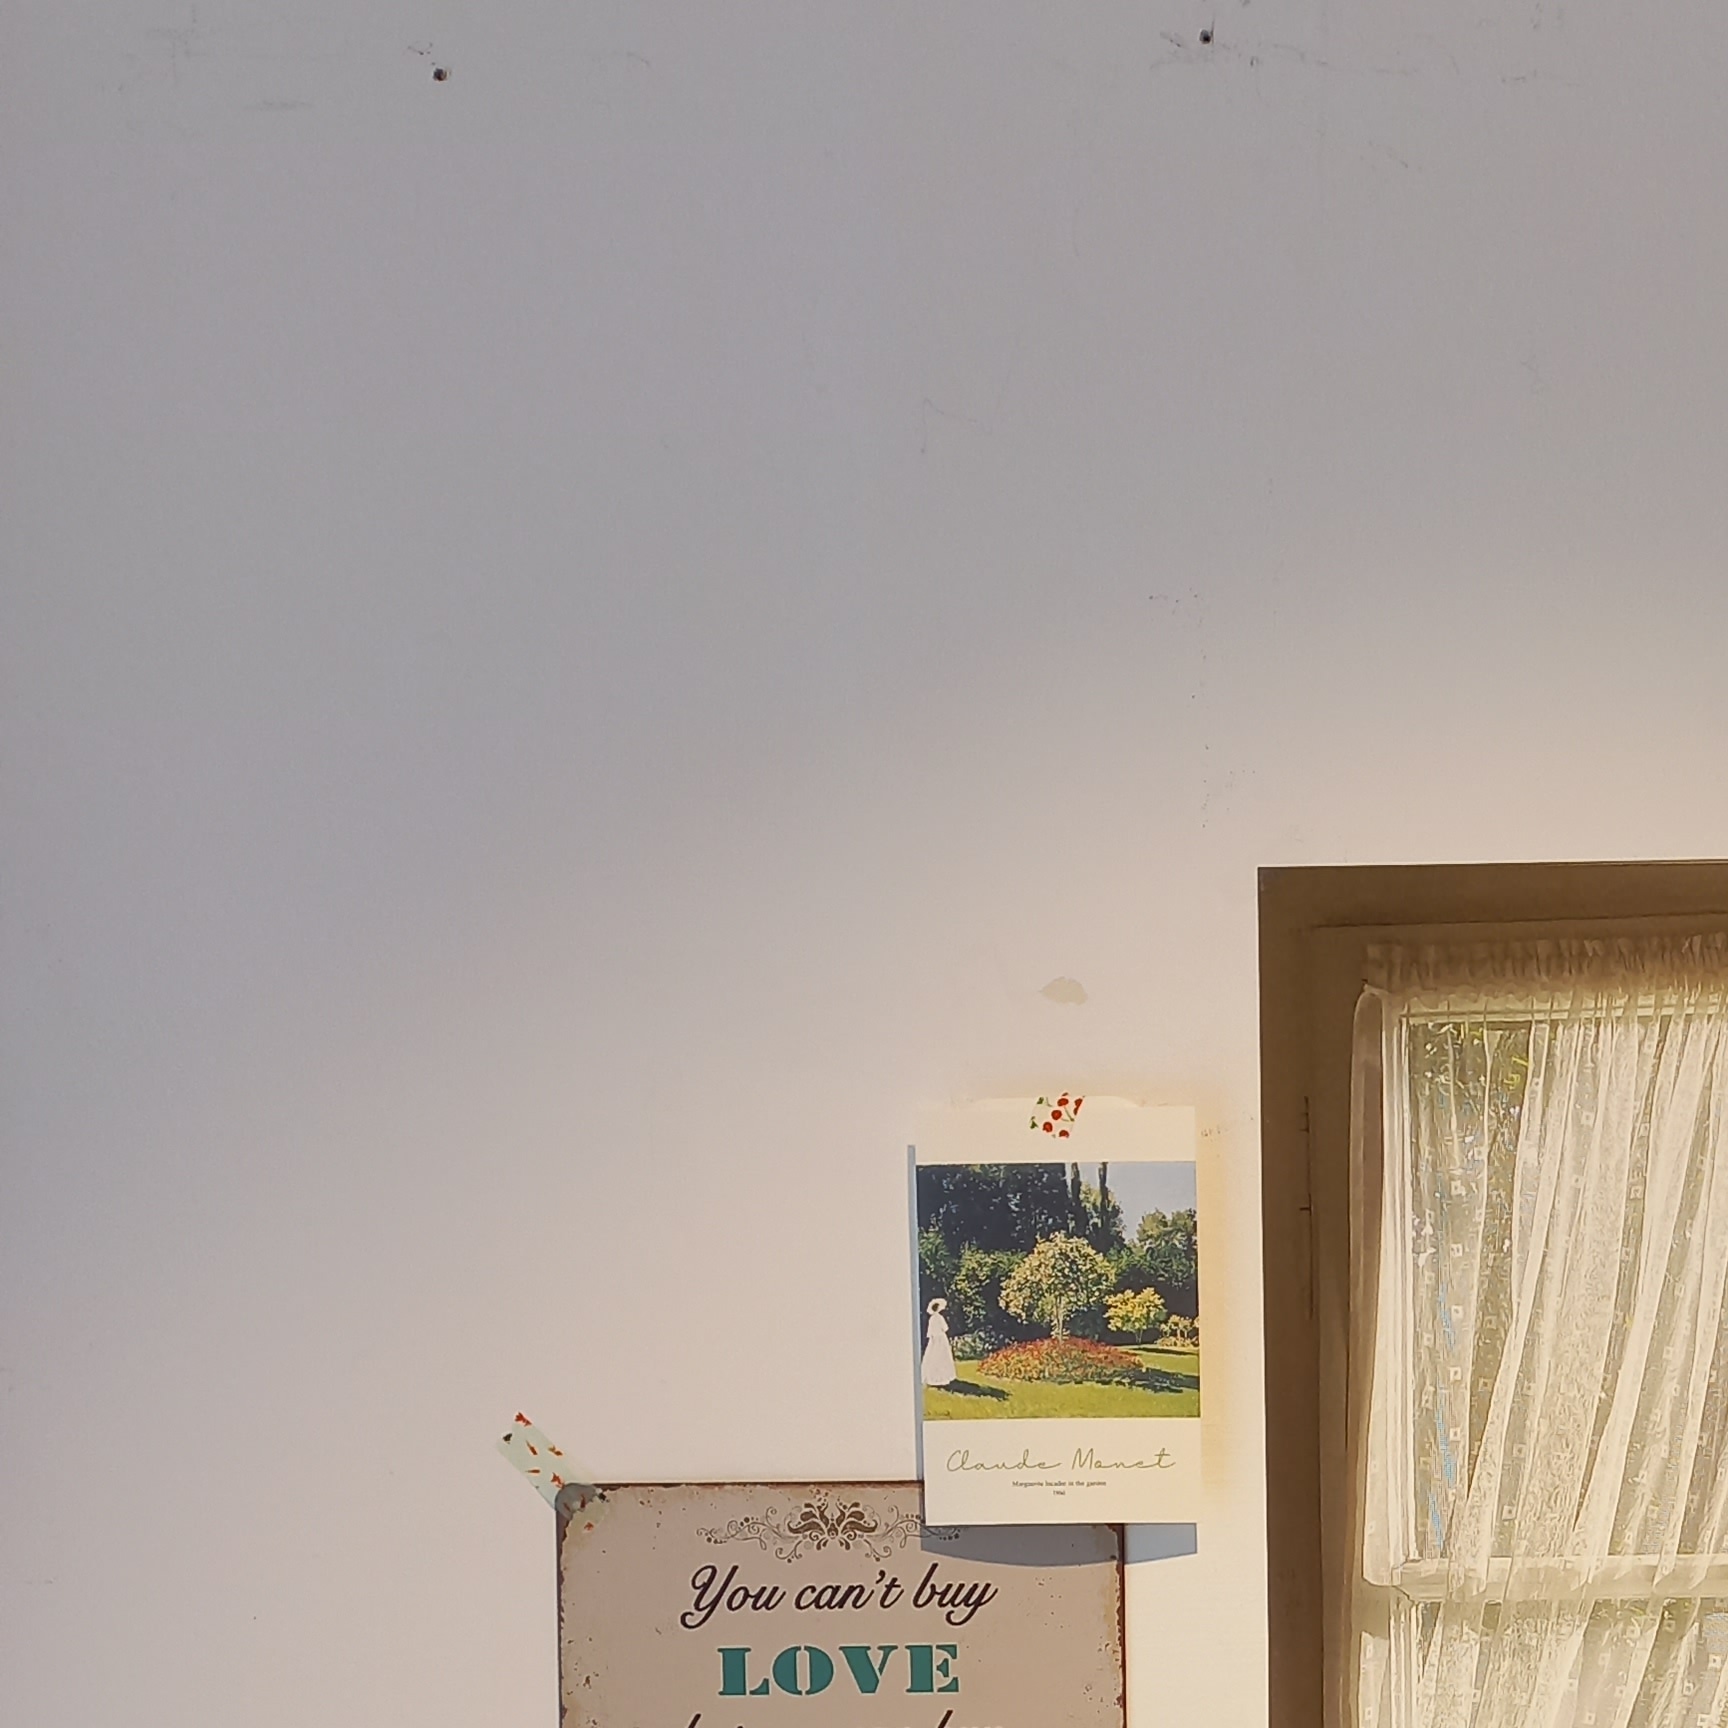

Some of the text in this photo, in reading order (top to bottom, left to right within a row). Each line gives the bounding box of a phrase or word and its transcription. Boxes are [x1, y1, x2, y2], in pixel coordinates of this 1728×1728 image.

[946, 1447, 1176, 1472] Claude Monet
[680, 1562, 998, 1630] You can't buy
[717, 1643, 960, 1696] LOVE
